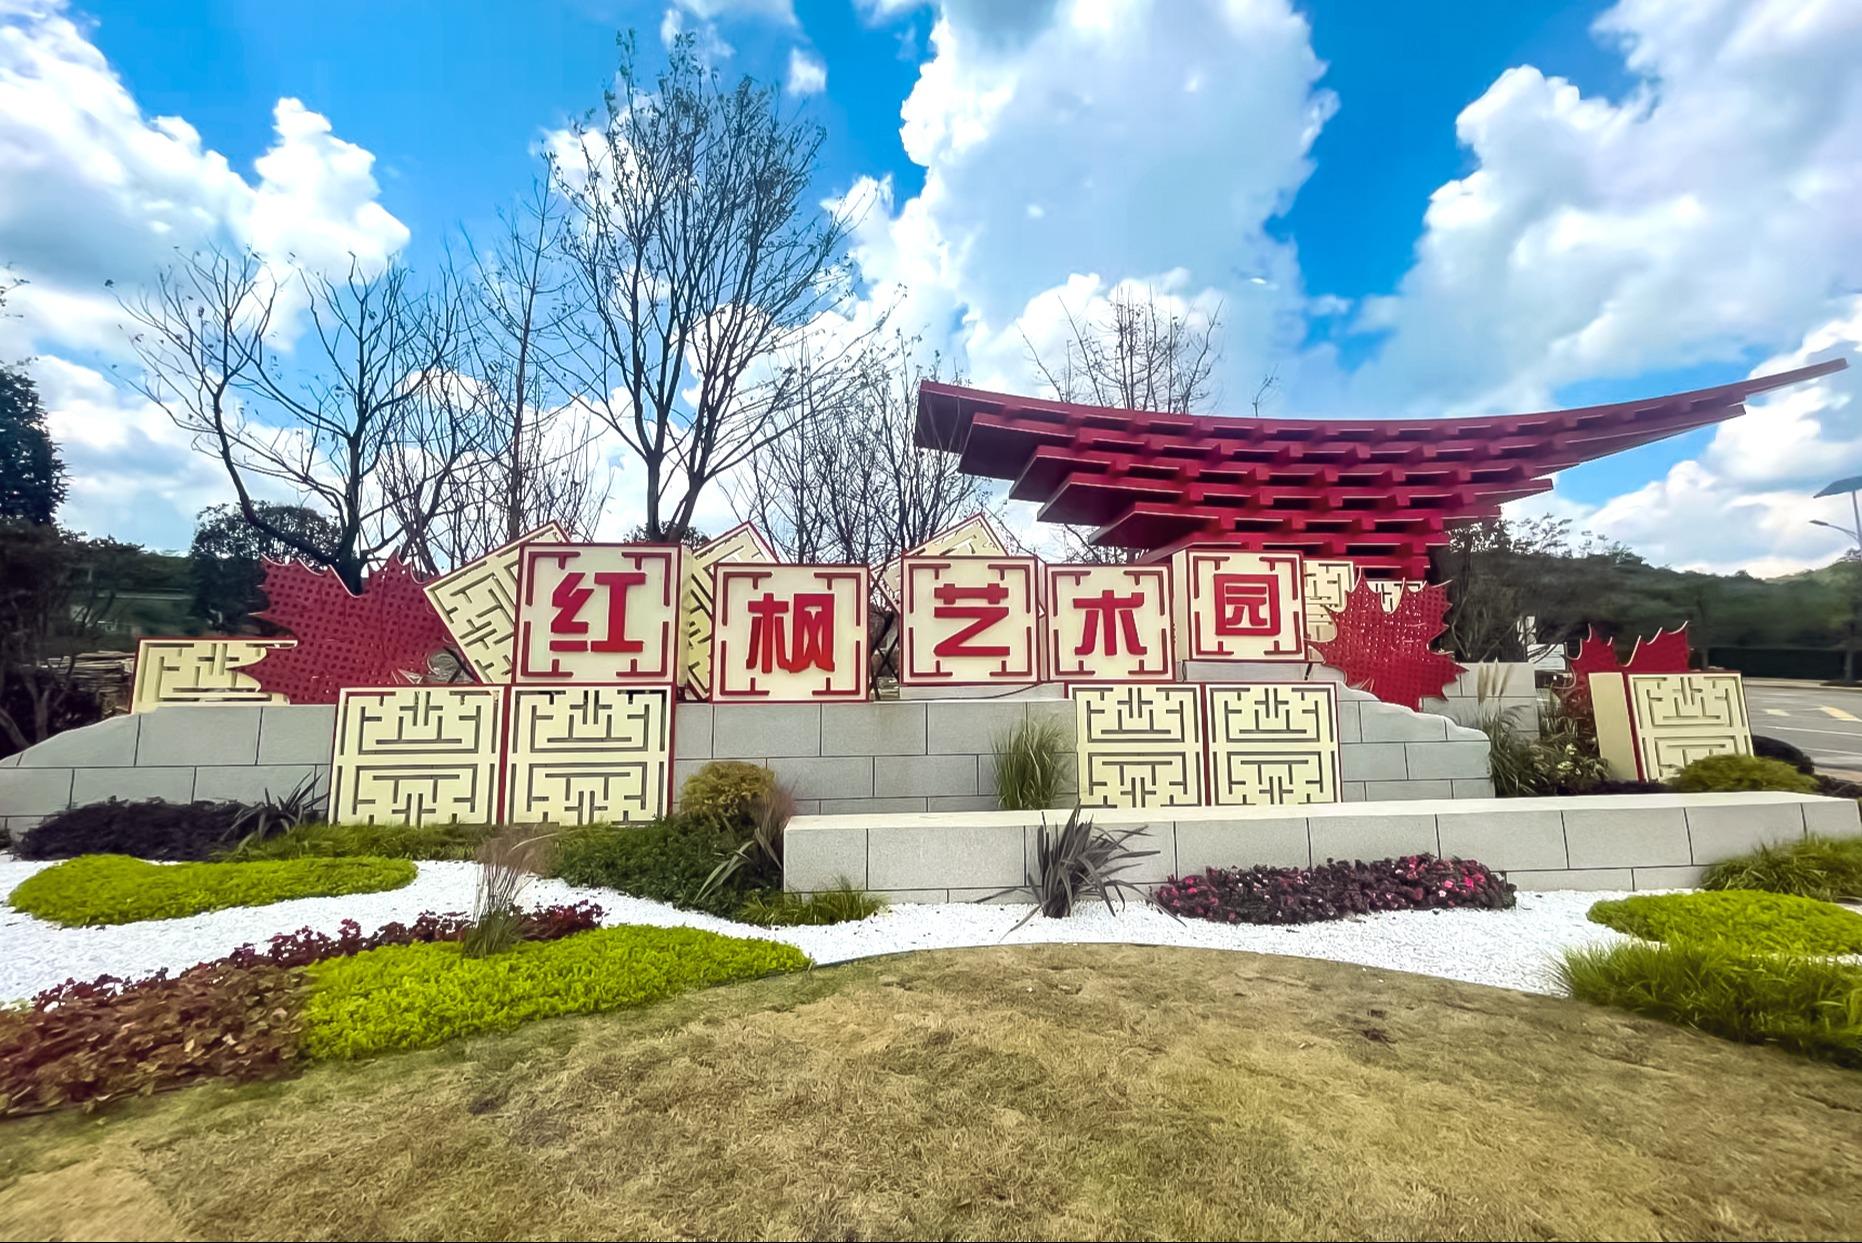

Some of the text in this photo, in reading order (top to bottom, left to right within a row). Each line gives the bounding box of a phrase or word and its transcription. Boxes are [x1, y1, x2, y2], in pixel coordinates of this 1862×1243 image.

[549, 571, 1281, 674] 红枫艺术园
